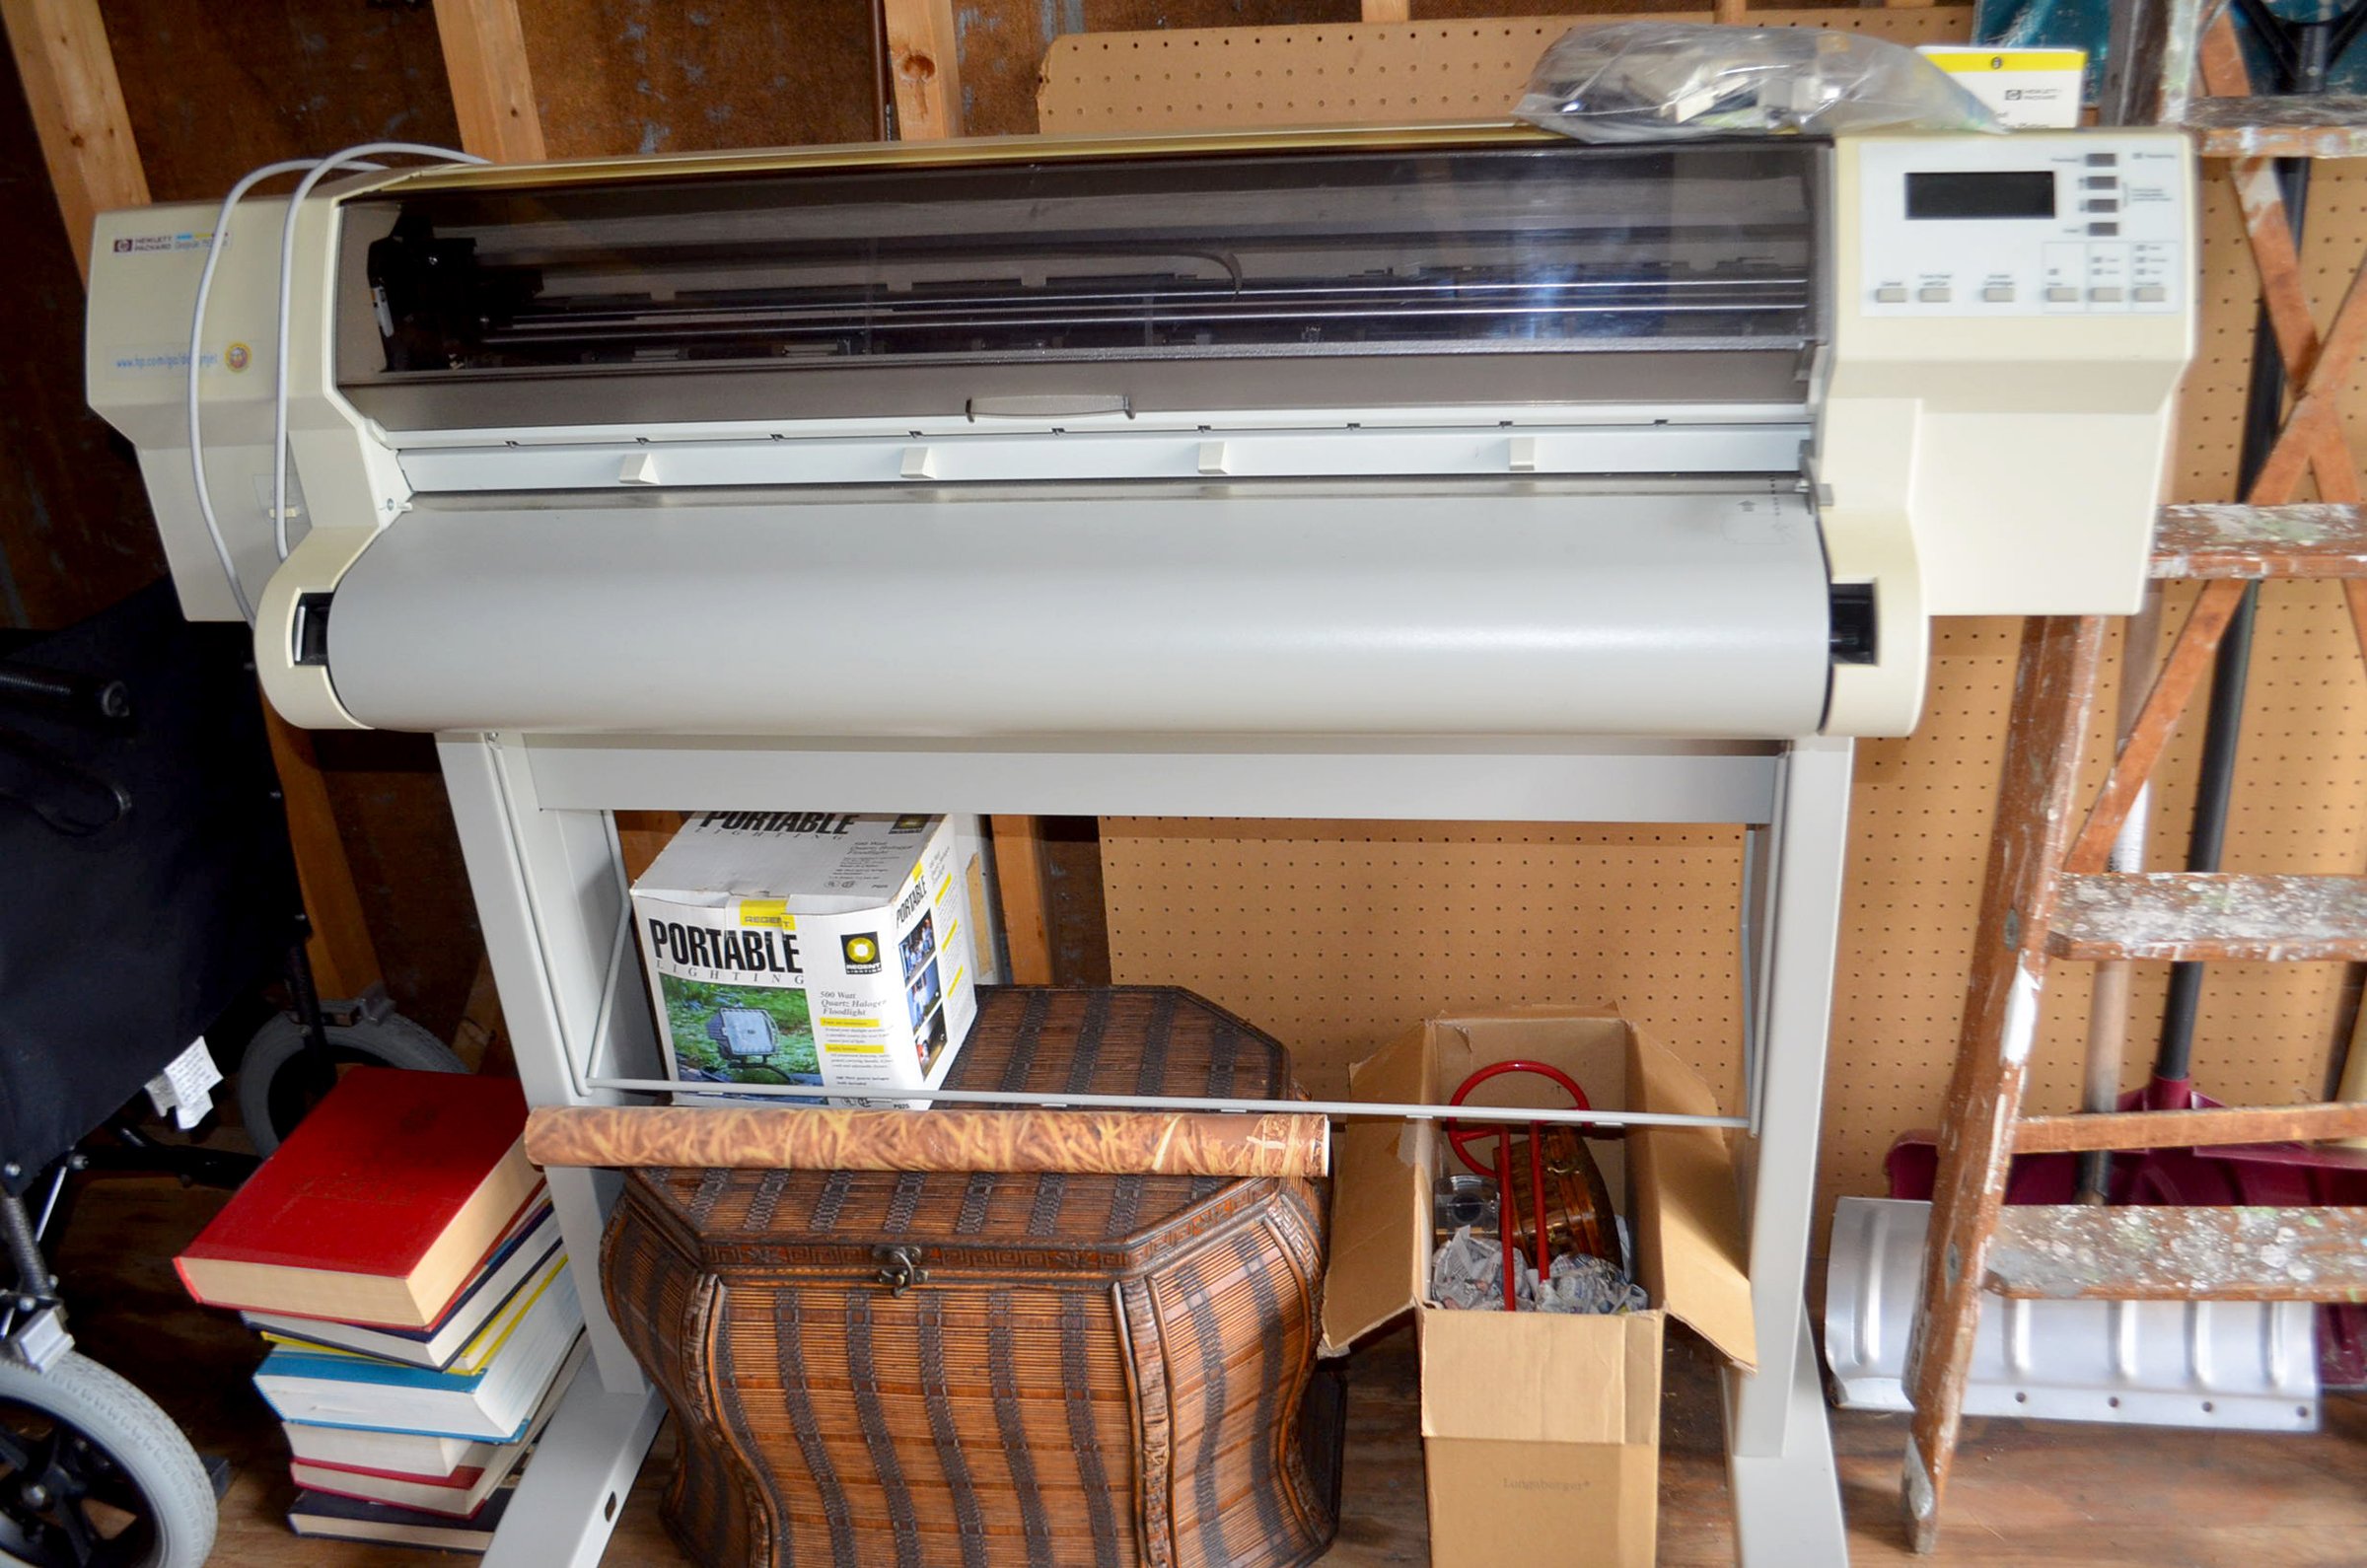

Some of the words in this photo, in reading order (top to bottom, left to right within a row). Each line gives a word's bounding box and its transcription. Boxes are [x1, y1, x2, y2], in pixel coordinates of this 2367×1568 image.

[698, 811, 860, 835] PORTABLE
[897, 875, 927, 929] PORTABLE
[649, 917, 804, 974] PORTABLE
[656, 960, 805, 985] LIGHTING
[820, 990, 835, 999] 500
[821, 998, 850, 1008] Quartz
[823, 1008, 866, 1017] Floodlight
